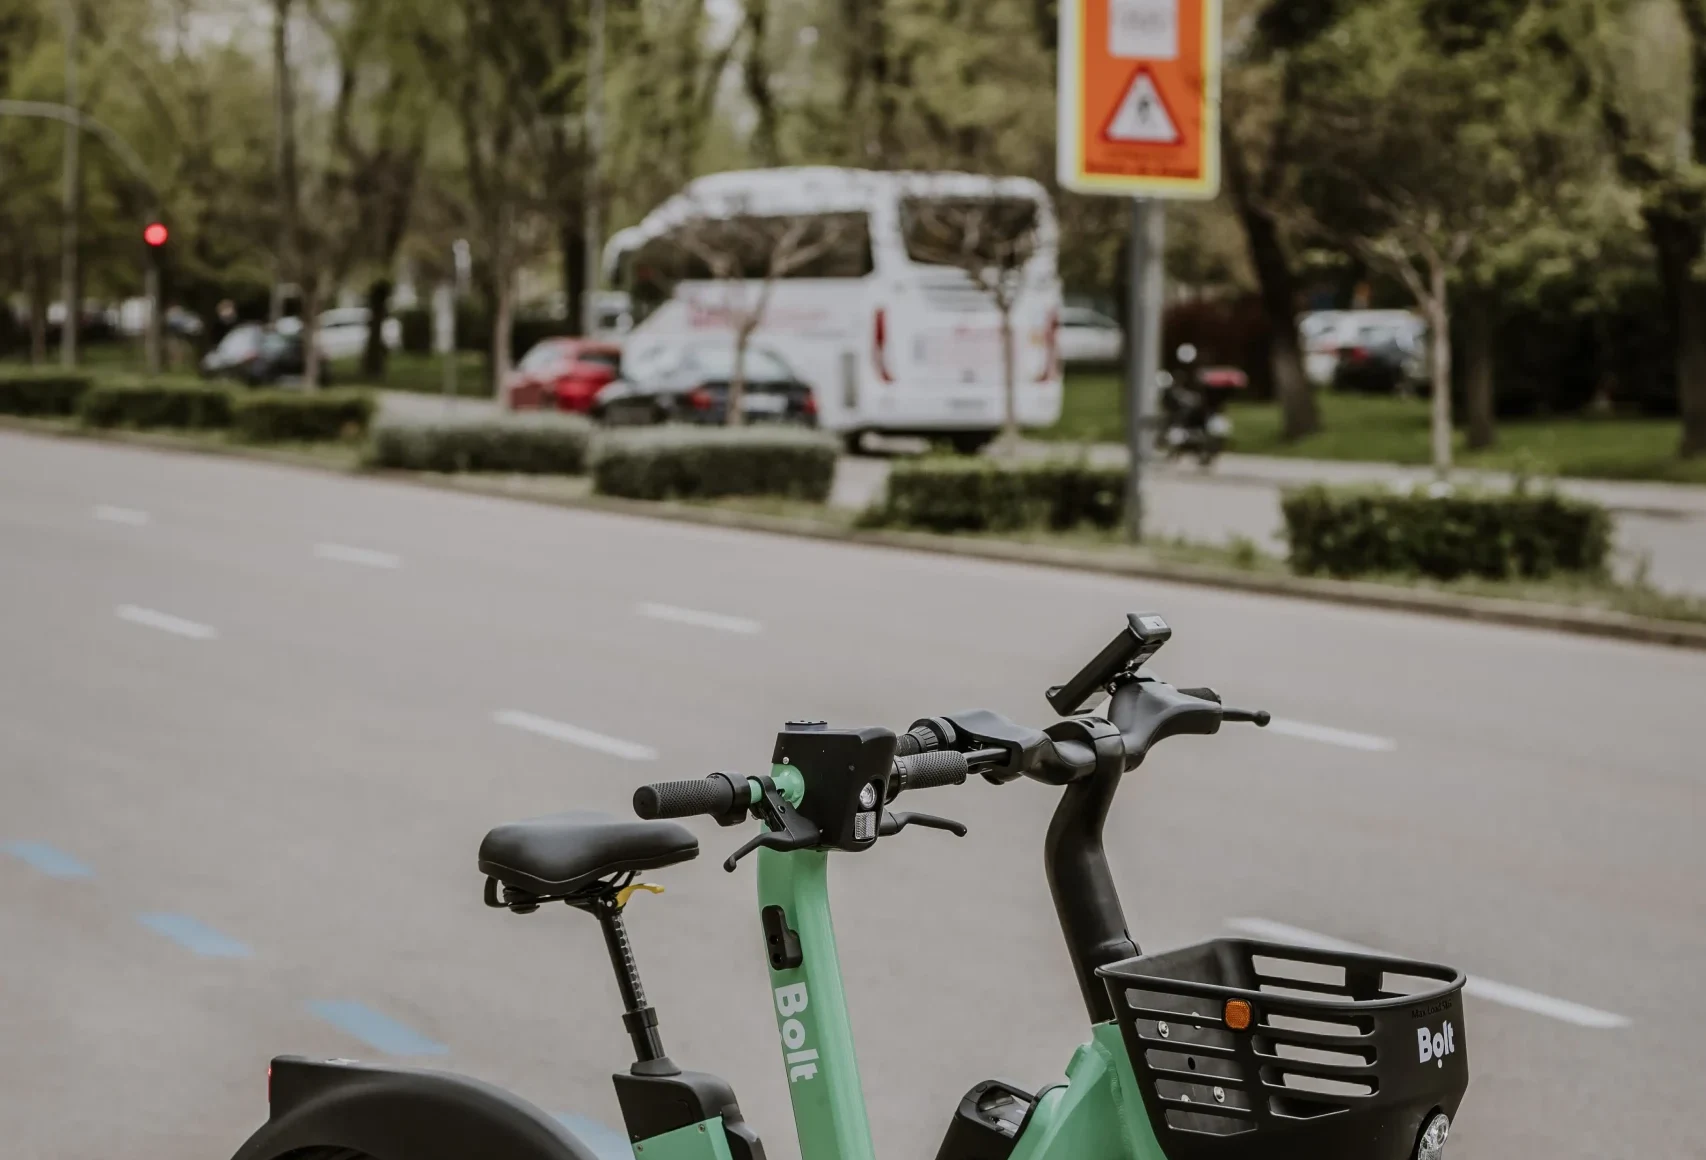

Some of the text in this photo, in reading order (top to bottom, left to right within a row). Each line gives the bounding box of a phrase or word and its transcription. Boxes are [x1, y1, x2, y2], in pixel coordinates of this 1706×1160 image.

[774, 981, 820, 1083] Bolt
[1411, 1009, 1426, 1019] Max
[1417, 1020, 1455, 1068] Bolt
